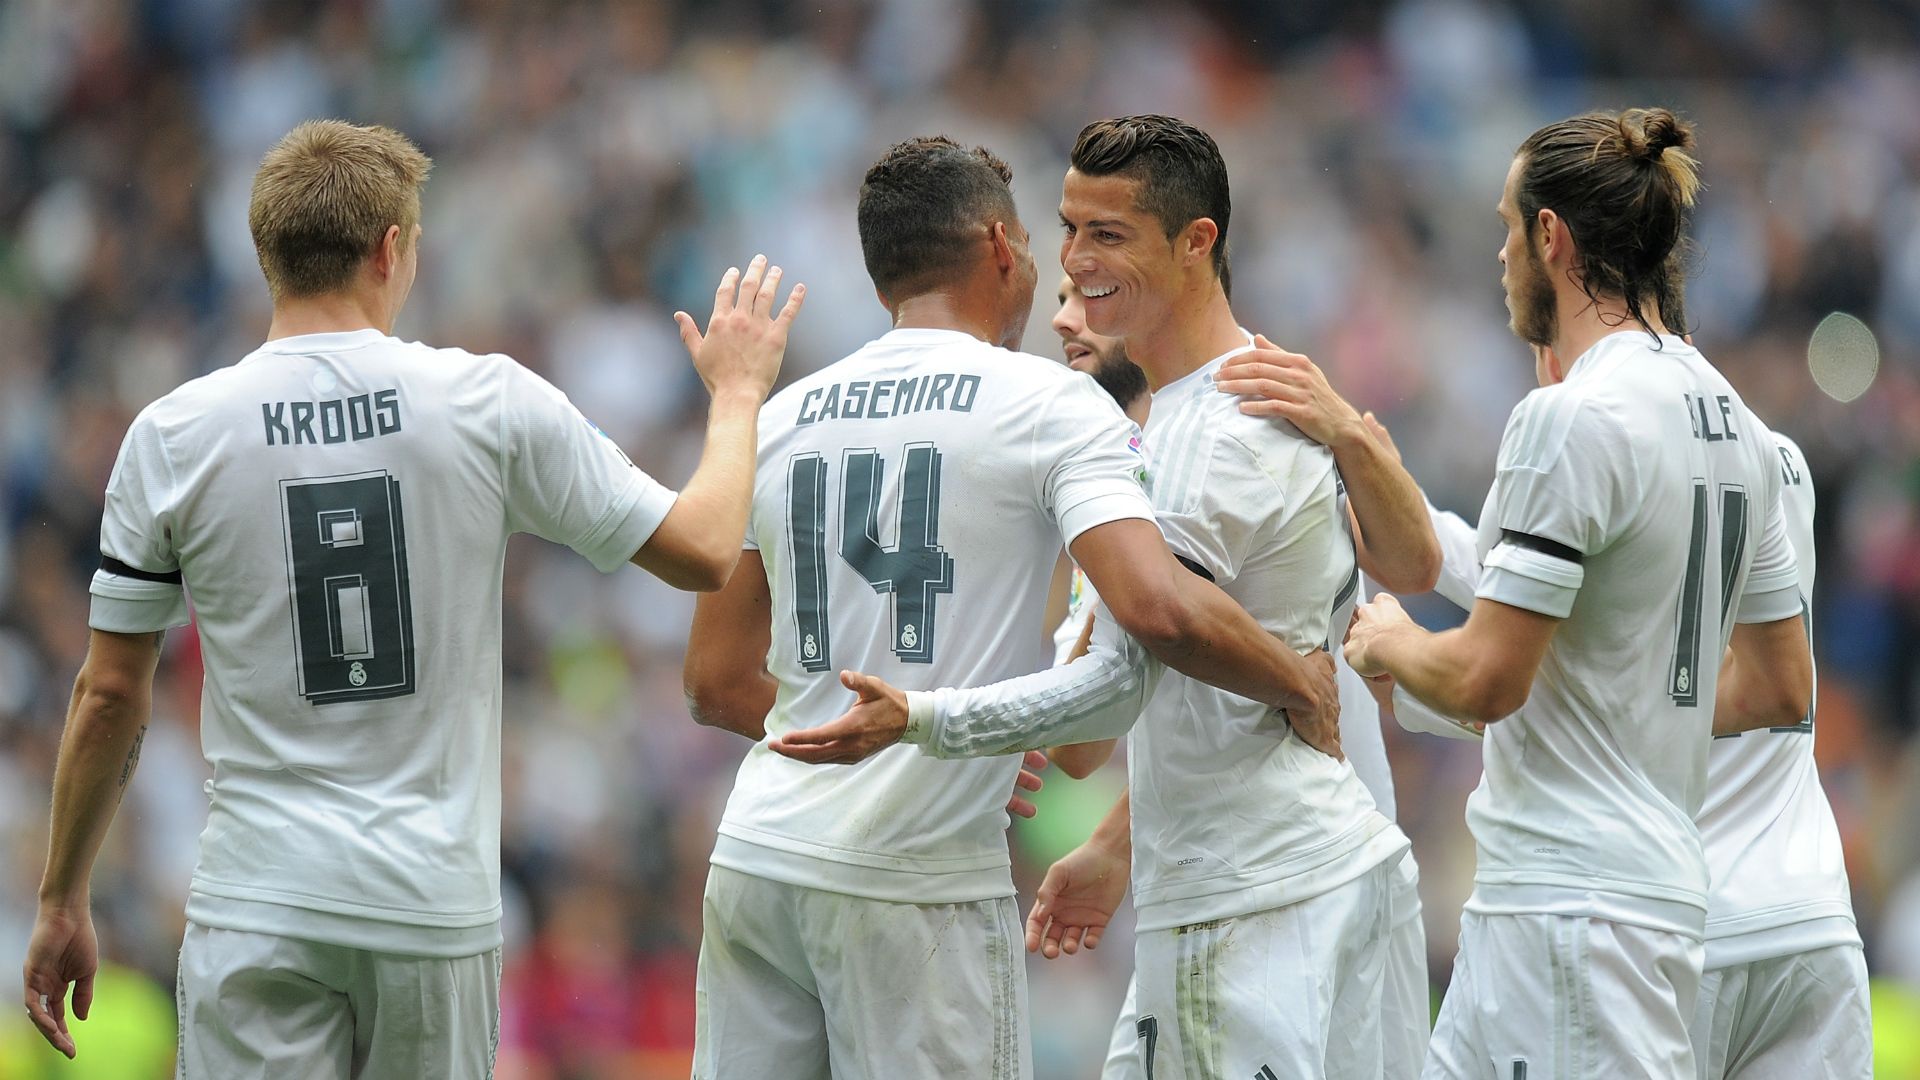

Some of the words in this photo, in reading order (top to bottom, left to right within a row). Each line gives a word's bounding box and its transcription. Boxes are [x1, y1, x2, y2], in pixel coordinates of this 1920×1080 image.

[262, 388, 402, 446] KROOS
[796, 373, 982, 427] CASEMIRO
[279, 469, 416, 706] 8
[785, 441, 954, 673] 14
[1667, 477, 1748, 707] 11
